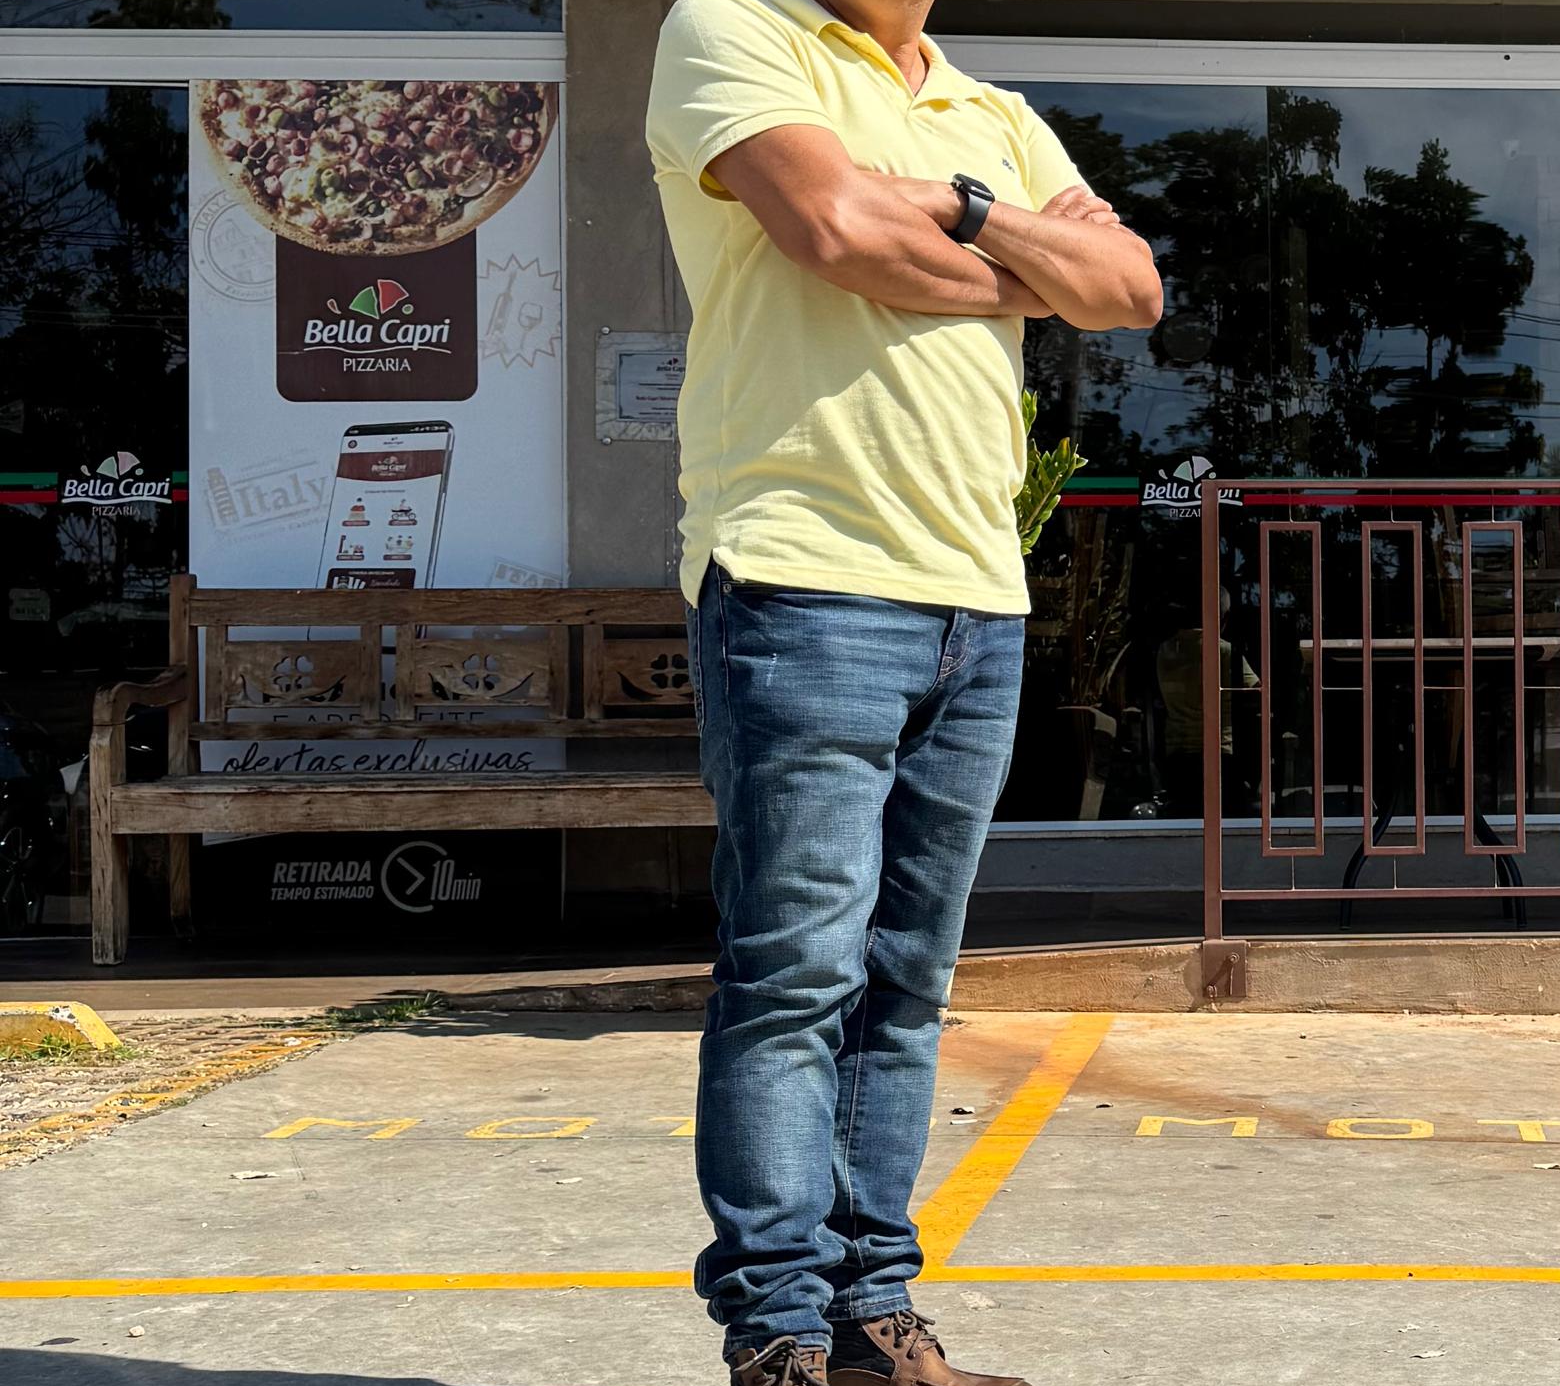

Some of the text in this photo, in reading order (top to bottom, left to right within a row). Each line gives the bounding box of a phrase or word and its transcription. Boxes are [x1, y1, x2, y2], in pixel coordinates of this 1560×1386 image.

[304, 319, 450, 351] Bella Capri
[343, 357, 411, 372] PIZZARIA
[64, 478, 170, 498] Bella Capri
[235, 473, 329, 518] Italy
[1143, 483, 1190, 500] Bella
[91, 506, 141, 517] PIZZARIA
[353, 738, 535, 772] exclusivas
[273, 860, 372, 884] RETIRADA
[271, 885, 375, 901] TEMPO ESTIMADO
